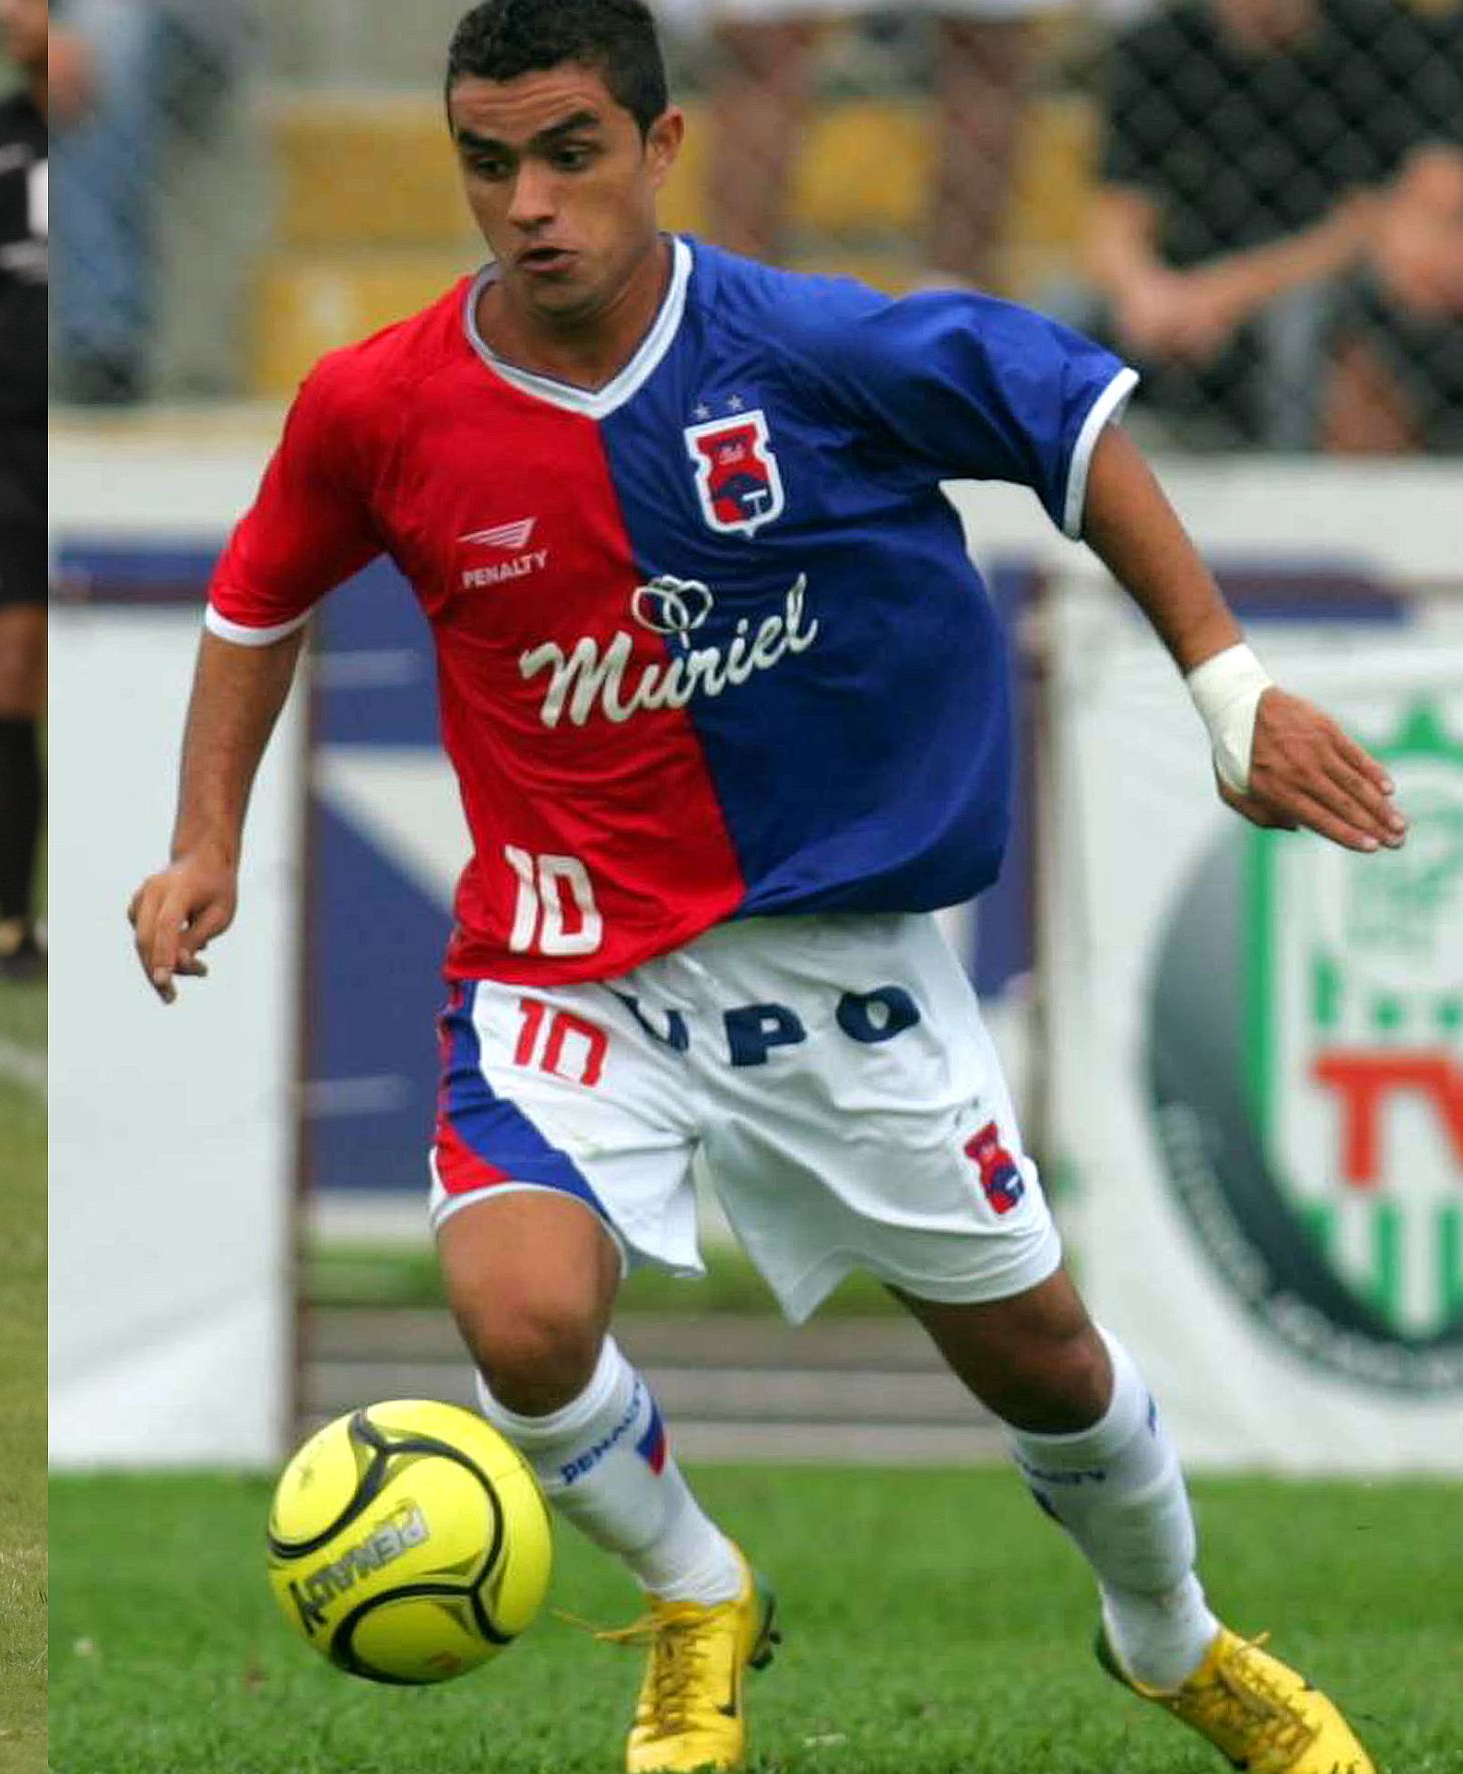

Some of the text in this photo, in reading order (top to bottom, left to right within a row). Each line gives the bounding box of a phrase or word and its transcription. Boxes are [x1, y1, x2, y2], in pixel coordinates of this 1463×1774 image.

[462, 549, 548, 589] PENALTY
[519, 573, 818, 727] Muriel
[505, 844, 603, 956] 10
[514, 998, 609, 1088] 10
